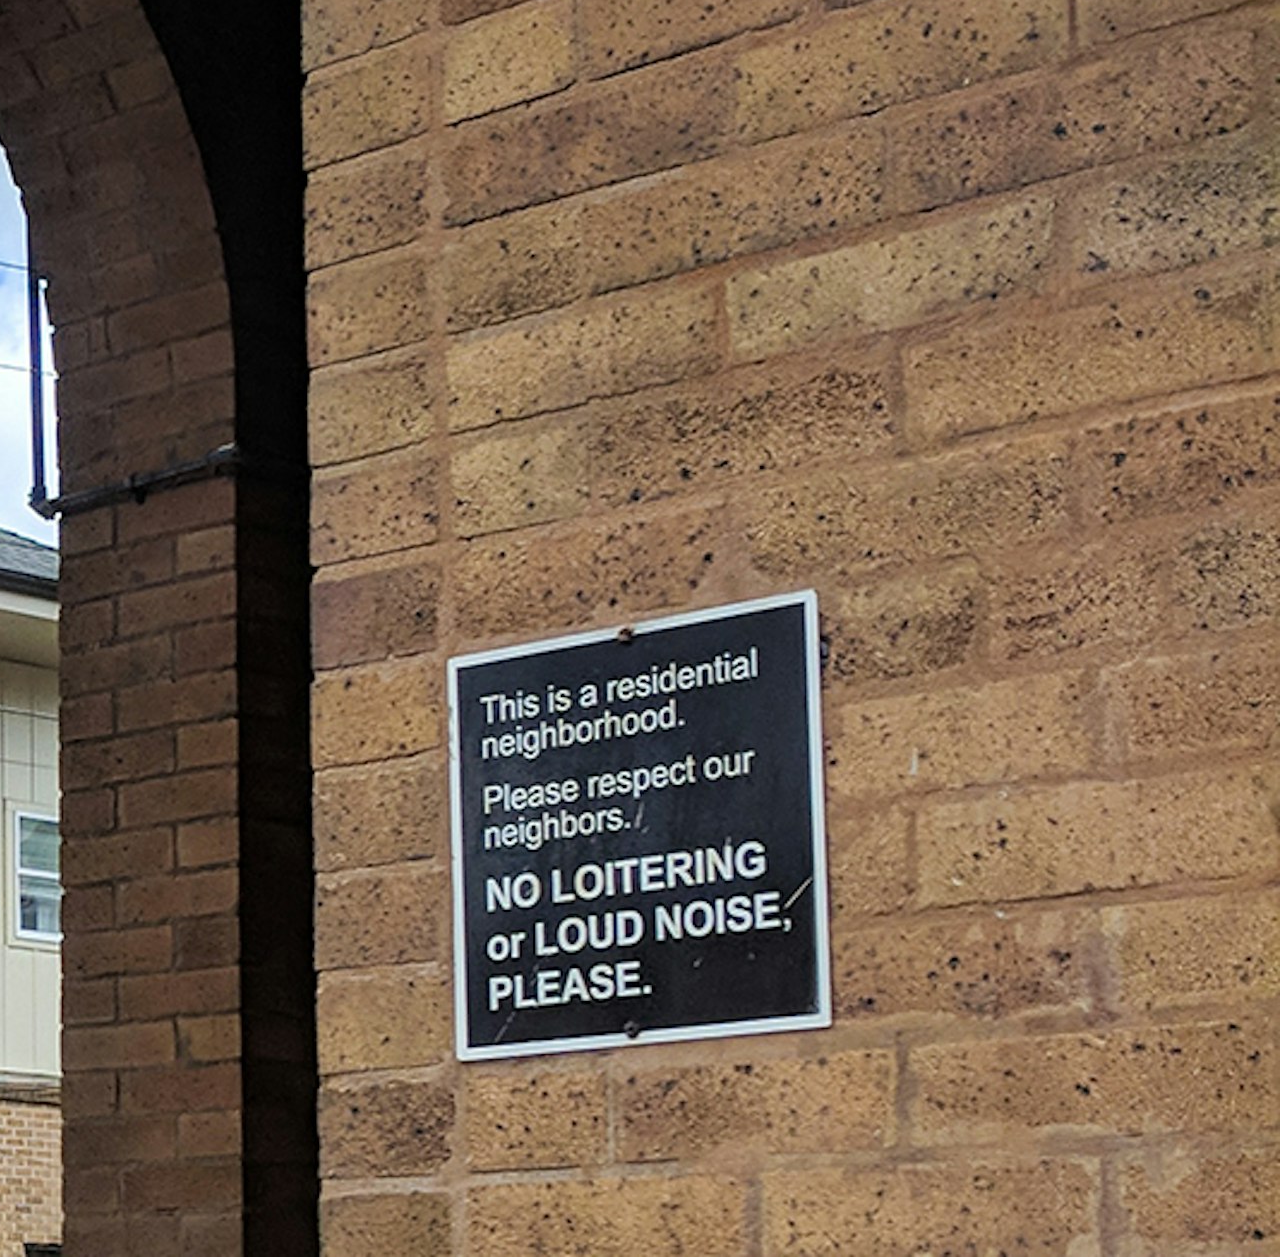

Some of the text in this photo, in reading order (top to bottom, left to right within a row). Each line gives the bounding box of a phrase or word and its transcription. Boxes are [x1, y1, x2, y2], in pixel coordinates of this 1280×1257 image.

[480, 647, 758, 724] This is a residential
[481, 699, 685, 760] neighborhood.
[484, 750, 756, 815] Please respect our
[484, 806, 632, 851] neighbors.
[486, 841, 767, 913] NO LOITERING
[486, 891, 792, 961] or LOUD NOISE,
[489, 960, 653, 1011] PLEASE.
